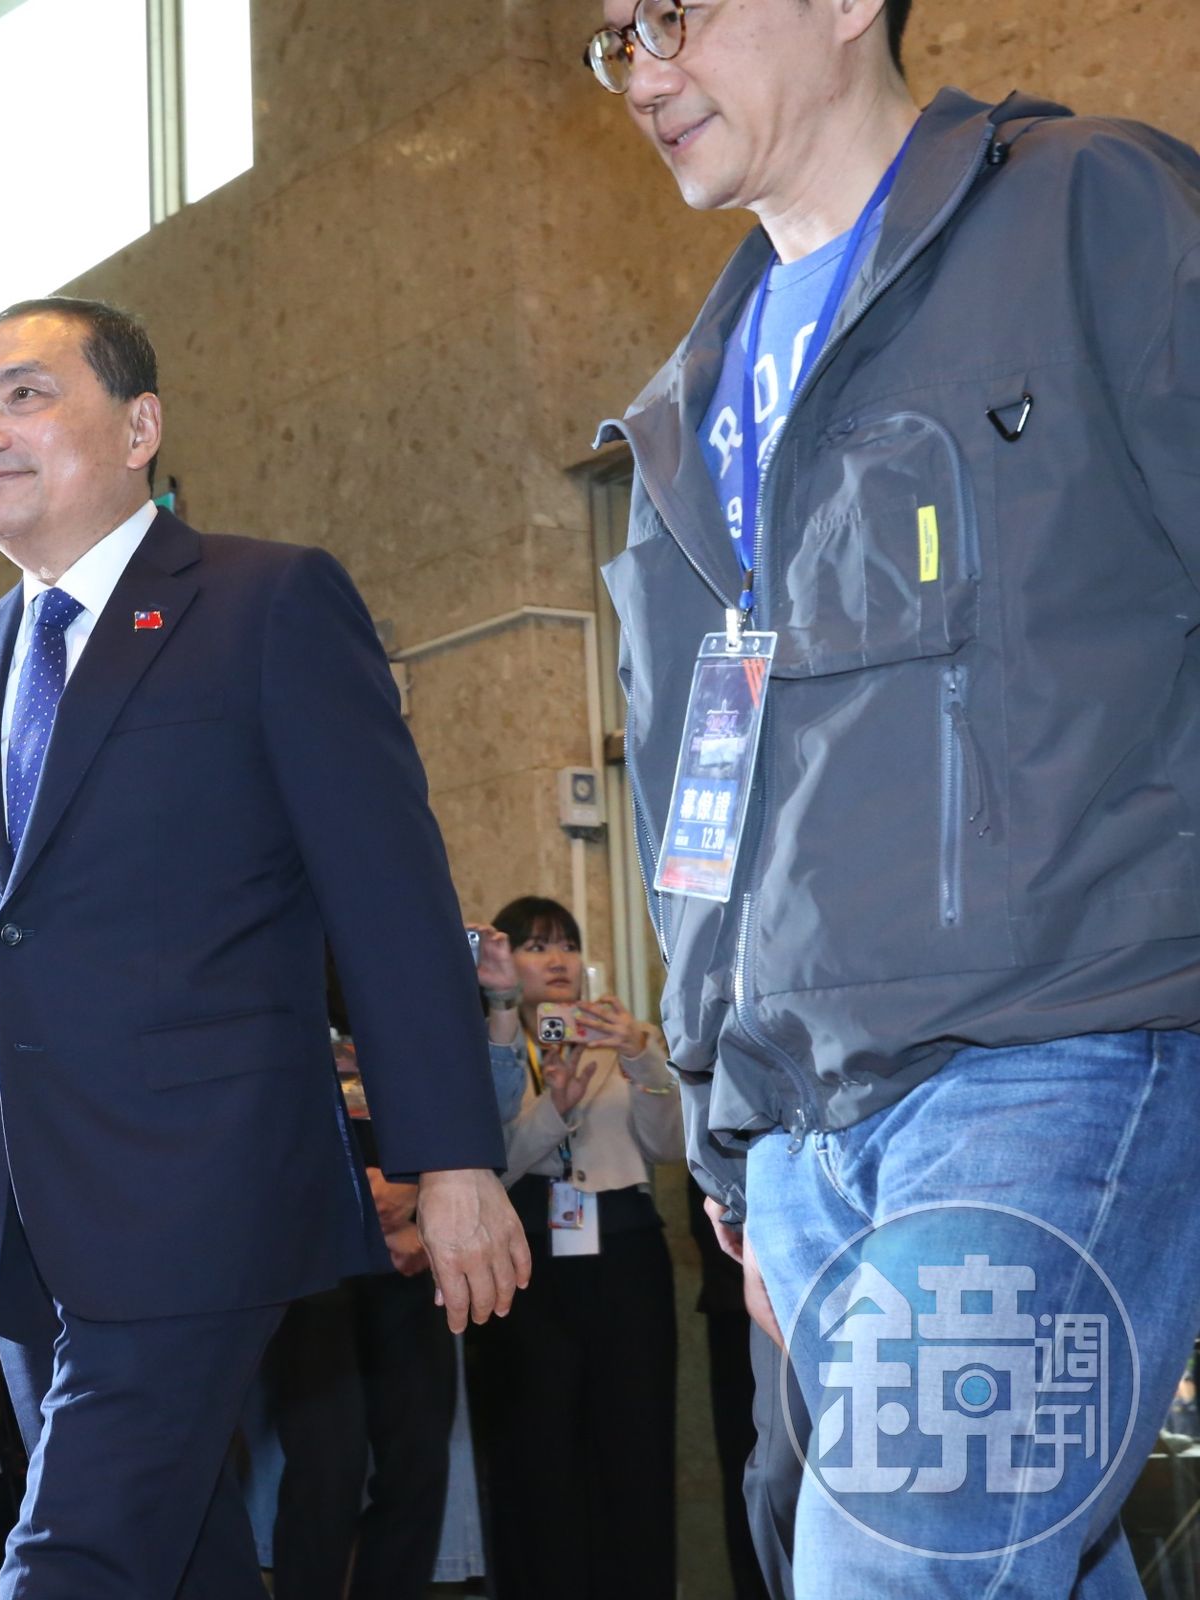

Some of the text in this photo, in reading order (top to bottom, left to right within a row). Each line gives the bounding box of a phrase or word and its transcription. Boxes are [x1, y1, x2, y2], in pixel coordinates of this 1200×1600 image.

[679, 787, 732, 823] 幕僚證
[701, 826, 727, 850] 12.30
